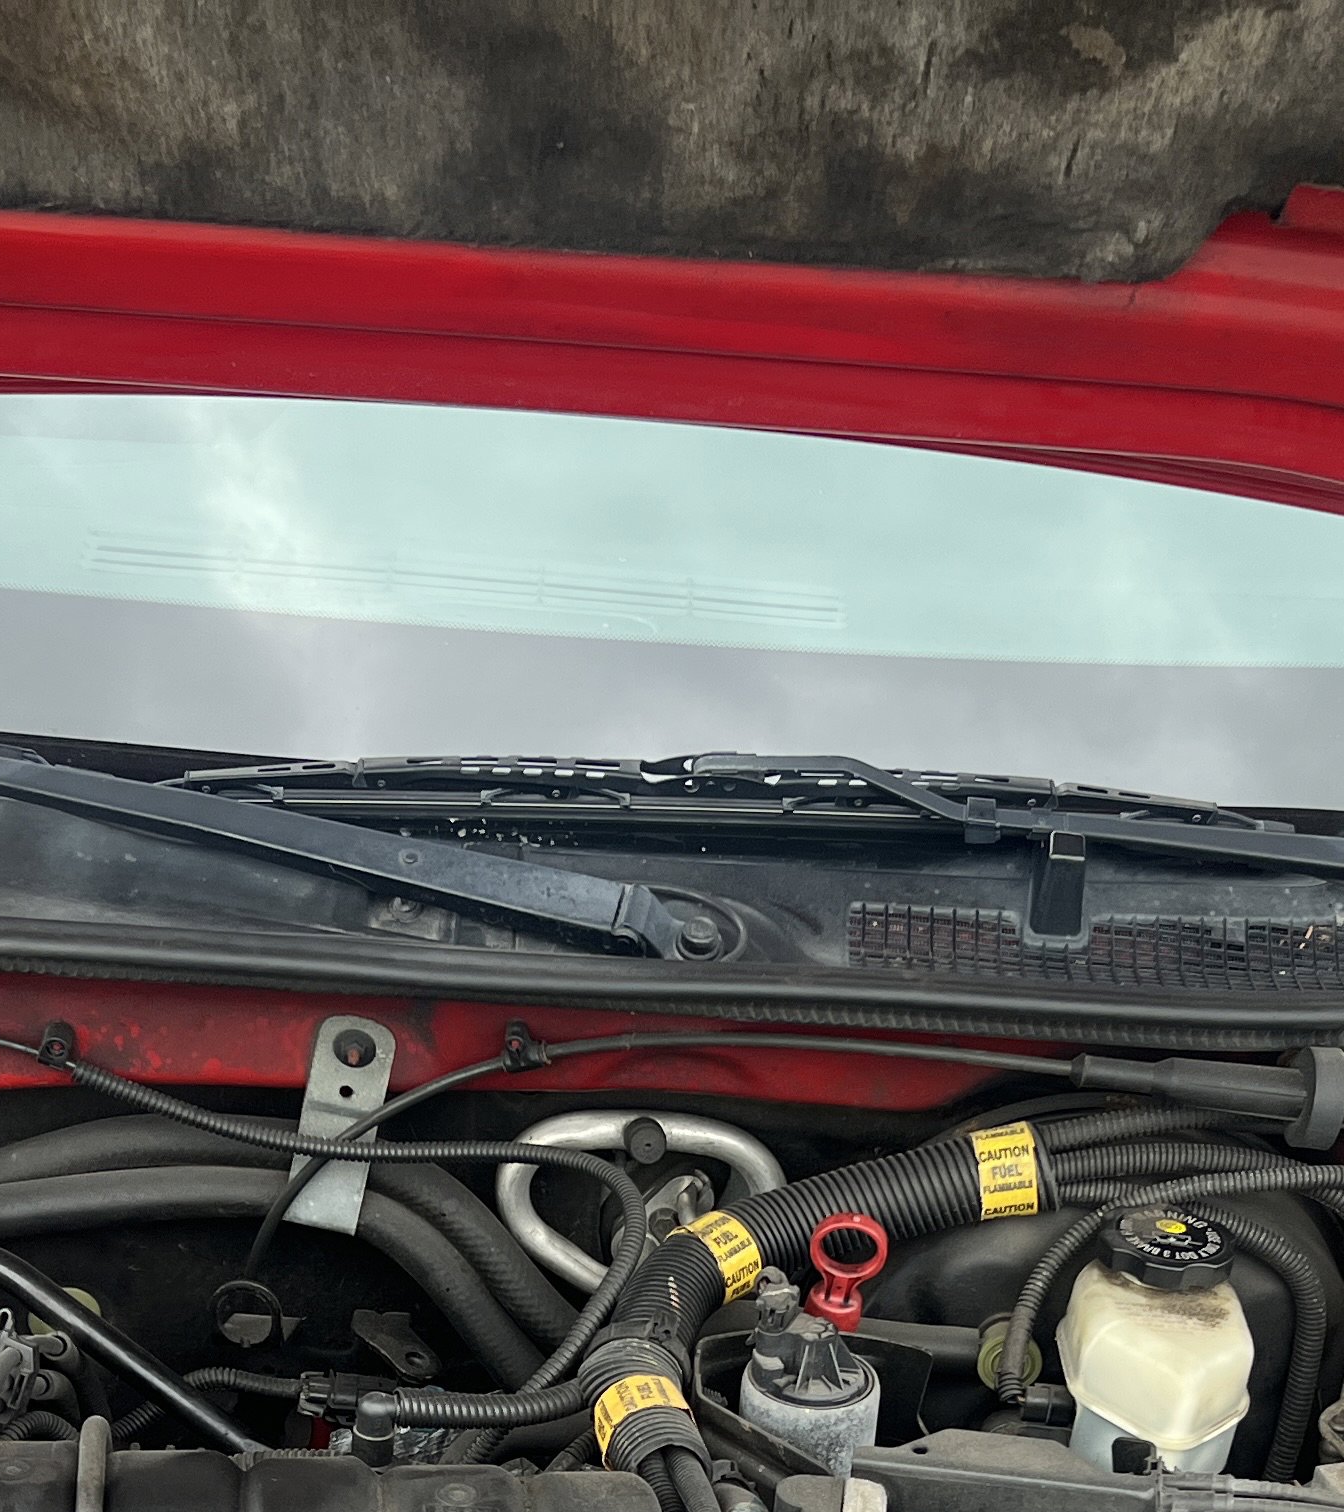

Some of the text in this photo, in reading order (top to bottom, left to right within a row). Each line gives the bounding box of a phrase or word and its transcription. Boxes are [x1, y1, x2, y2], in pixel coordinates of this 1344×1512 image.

[979, 1144, 1030, 1162] CAUTION
[991, 1164, 1023, 1180] FUEL
[983, 1180, 1032, 1194] FLAMMABLE
[984, 1203, 1034, 1215] CAUTION
[713, 1230, 739, 1248] FUEL
[725, 1258, 760, 1288] CAUTION
